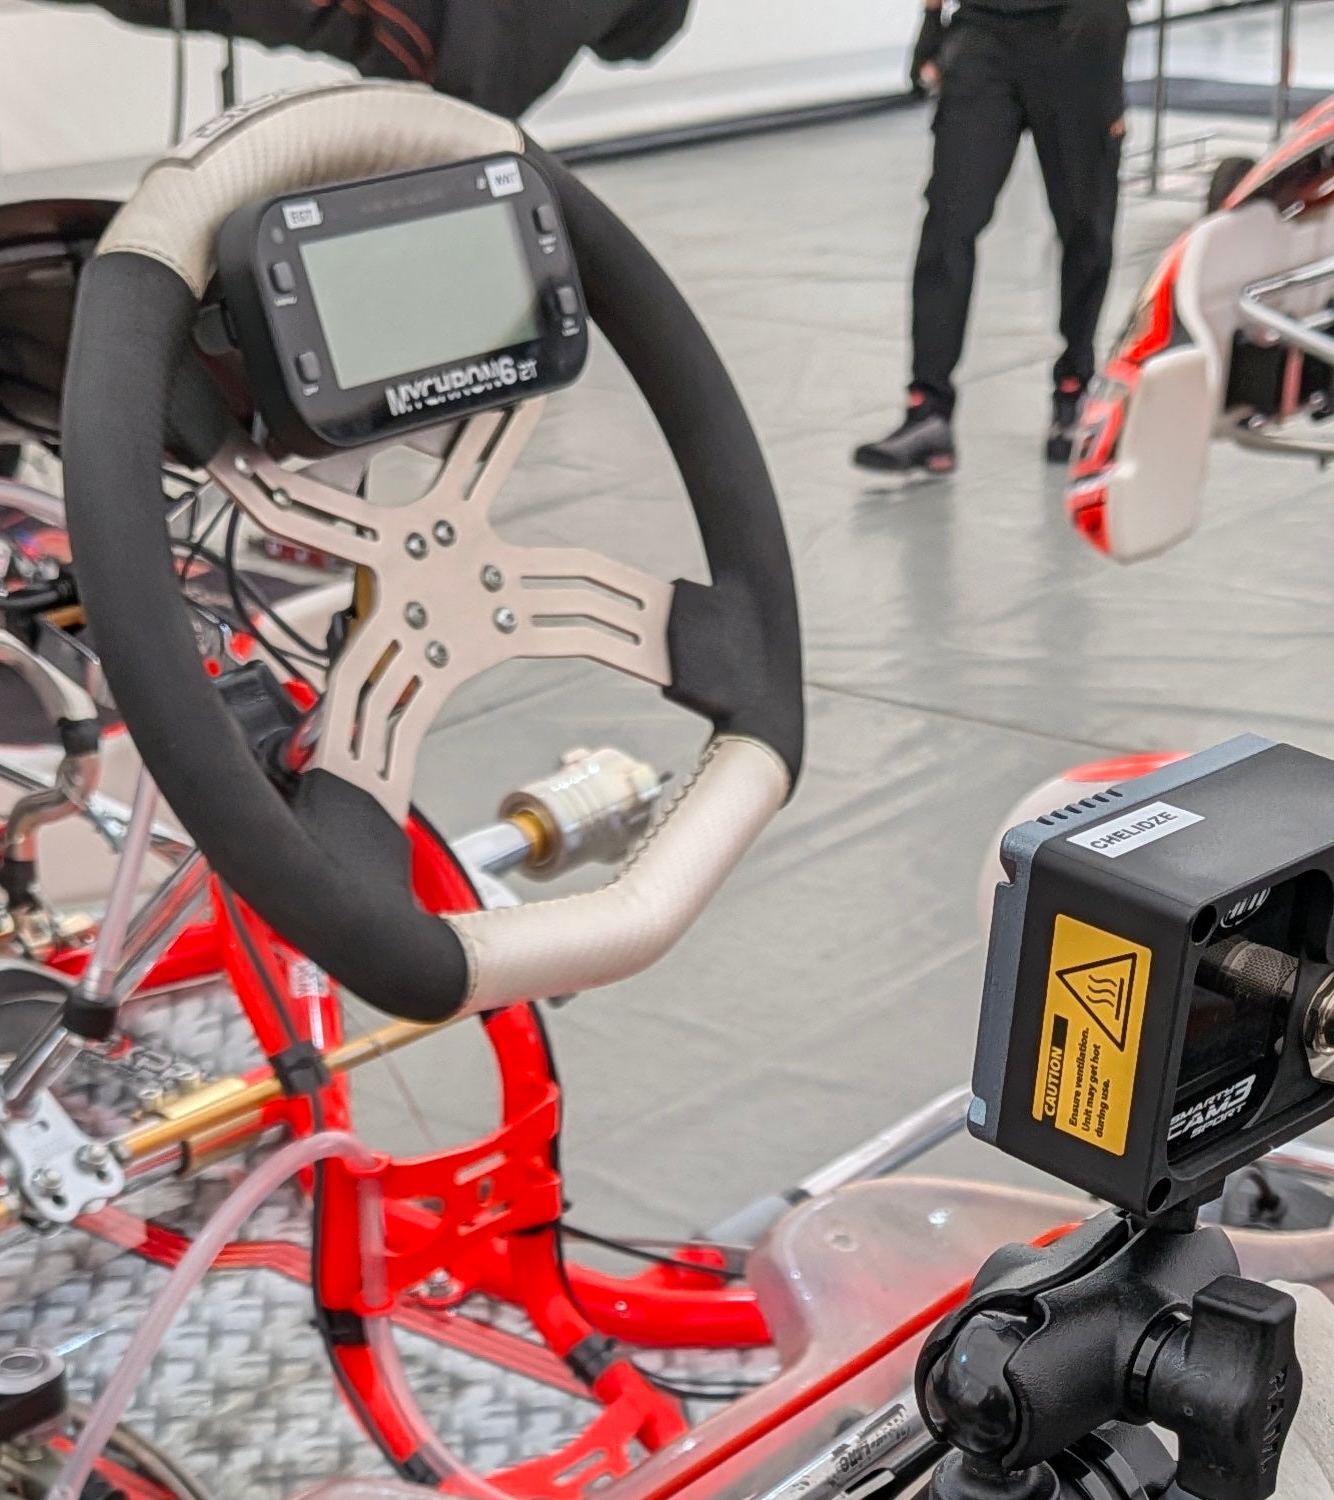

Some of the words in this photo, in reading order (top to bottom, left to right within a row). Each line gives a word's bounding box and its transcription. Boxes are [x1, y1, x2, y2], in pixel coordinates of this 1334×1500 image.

[1090, 811, 1178, 849] CHELIDZE
[1075, 1027, 1089, 1088] ventilation.
[1090, 1043, 1101, 1064] hot
[1044, 1046, 1063, 1117] CAUTION
[1090, 1064, 1099, 1084] get
[1101, 1079, 1111, 1101] use.
[1069, 1090, 1082, 1127] Ensure
[1087, 1083, 1097, 1108] may
[1082, 1109, 1092, 1132] Unit
[1095, 1101, 1109, 1138] during
[1190, 1101, 1247, 1139] SPORT
